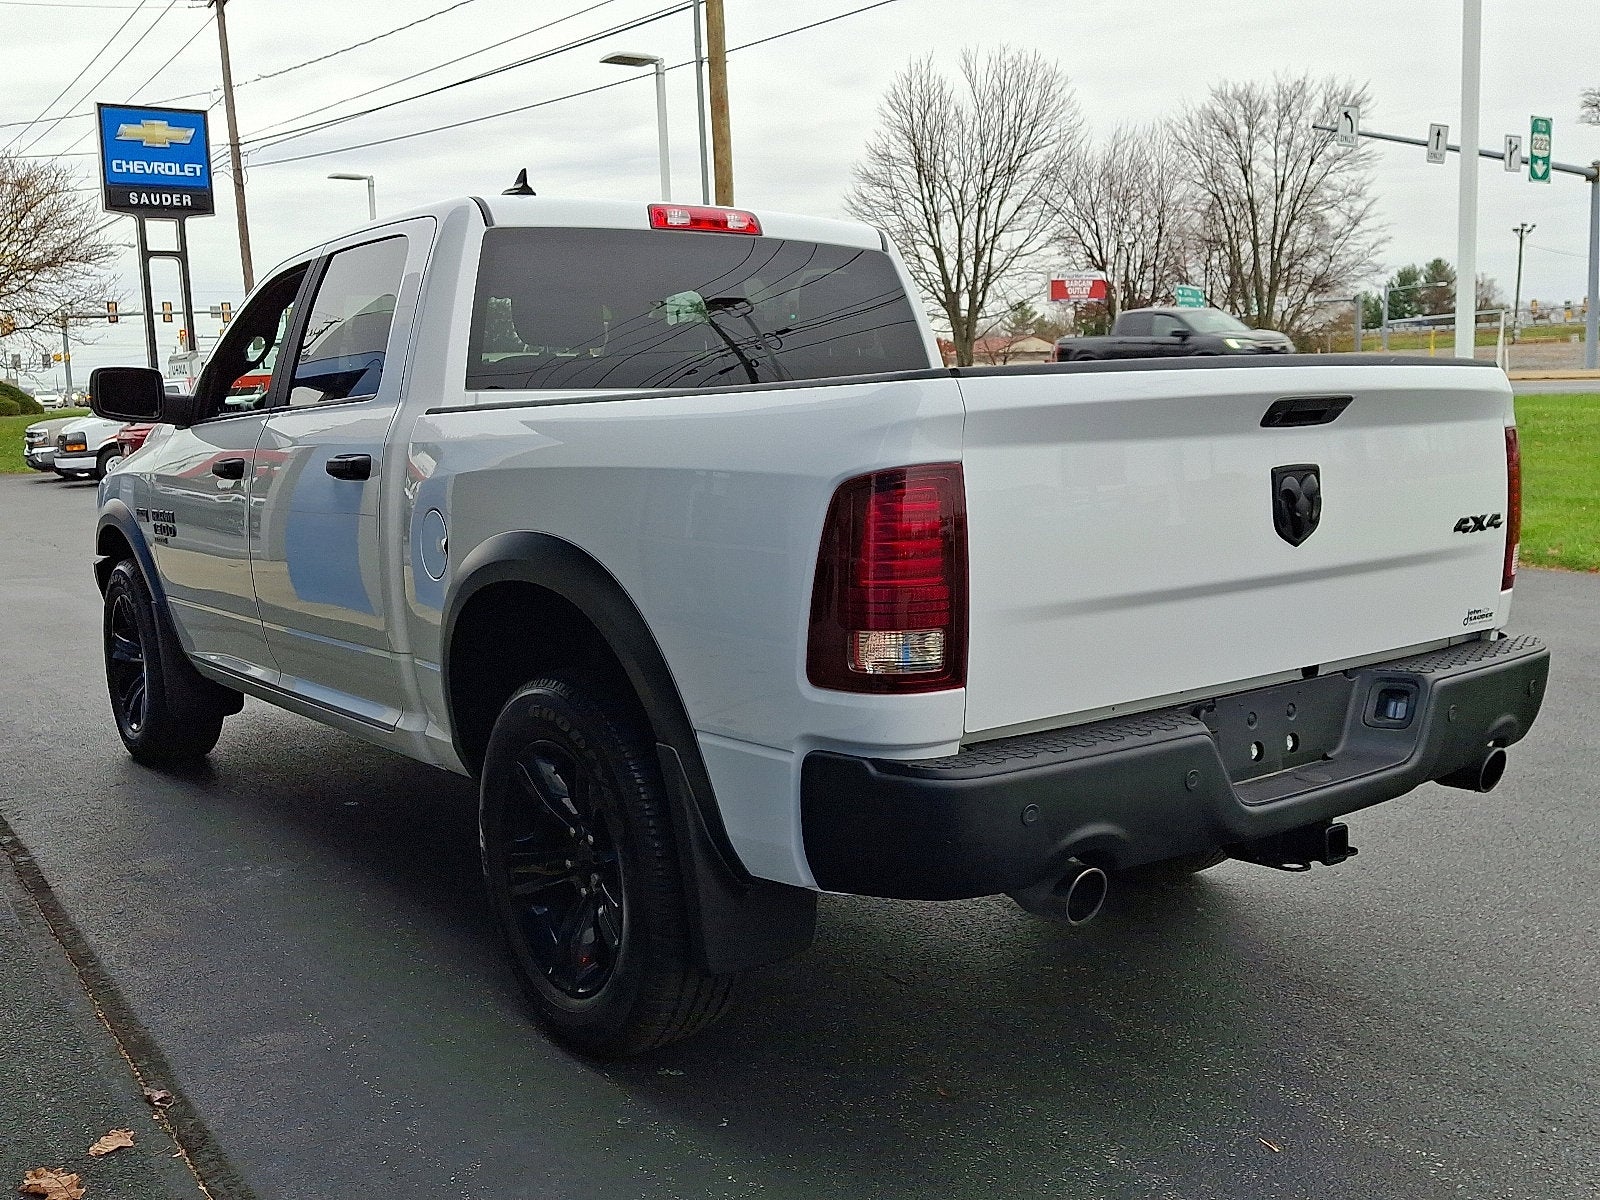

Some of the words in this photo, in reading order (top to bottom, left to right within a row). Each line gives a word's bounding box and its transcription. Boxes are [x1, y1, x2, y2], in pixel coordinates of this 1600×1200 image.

[1532, 137, 1549, 151] 222
[112, 159, 203, 177] CHEVROLET
[129, 192, 192, 206] SAUDER
[1067, 287, 1091, 295] OUTLET
